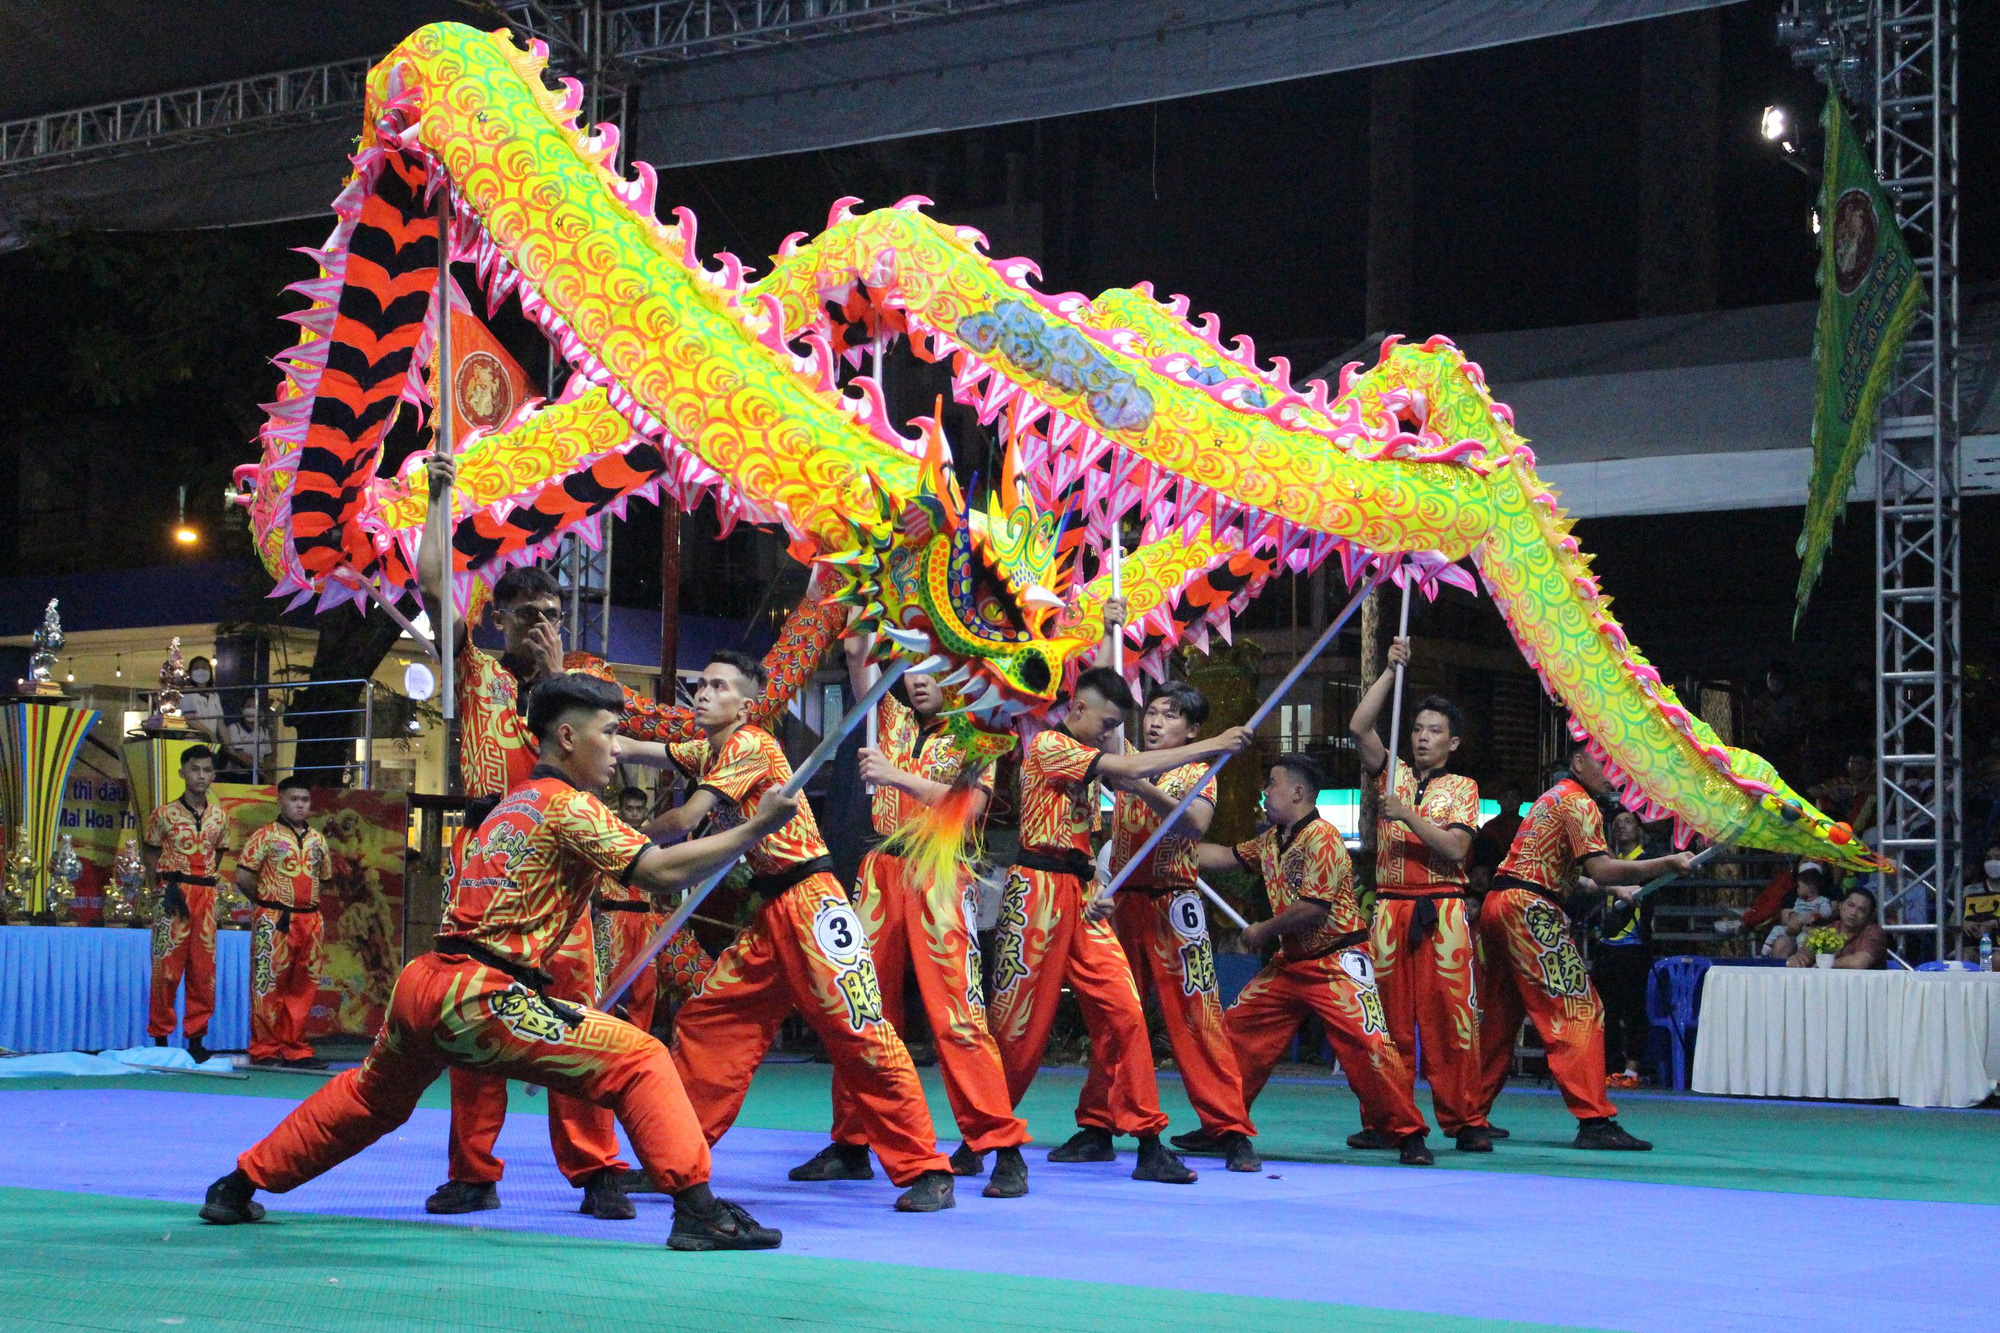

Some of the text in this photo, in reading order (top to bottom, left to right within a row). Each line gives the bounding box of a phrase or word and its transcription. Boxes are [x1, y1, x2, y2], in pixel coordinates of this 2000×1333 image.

[72, 780, 92, 800] thi
[86, 809, 113, 829] Hoa
[1182, 902, 1198, 929] 6
[829, 916, 853, 948] 3
